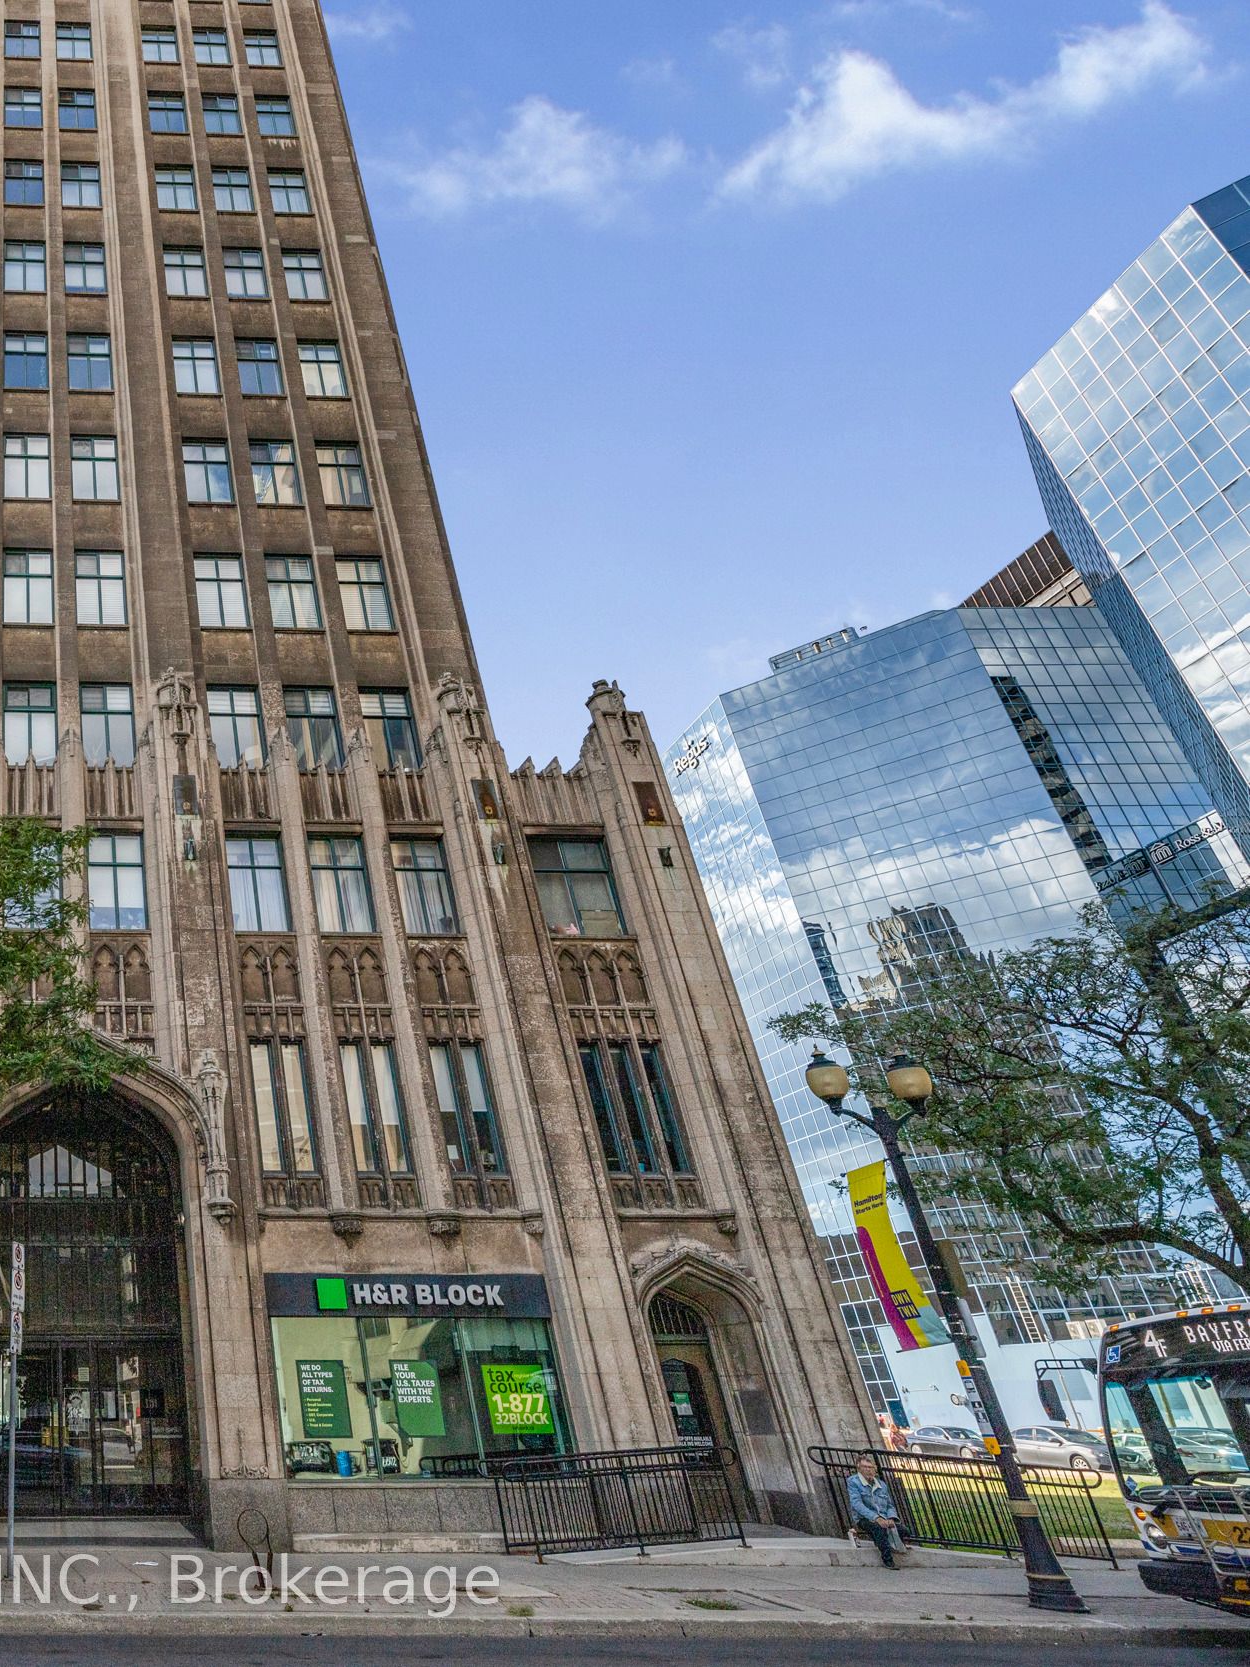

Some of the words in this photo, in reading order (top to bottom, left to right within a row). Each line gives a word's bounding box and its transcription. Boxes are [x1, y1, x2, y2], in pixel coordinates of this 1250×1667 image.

[673, 739, 710, 775] Regus
[1174, 833, 1201, 851] Ross
[853, 1193, 883, 1207] Hamilton
[352, 1283, 409, 1305] H&R
[414, 1284, 505, 1306] BLOCK
[1182, 1319, 1250, 1344] BAYFR
[1211, 1340, 1234, 1353] VIA
[393, 1363, 410, 1371] FILE
[394, 1371, 416, 1379] YOUR
[487, 1368, 515, 1382] tax
[396, 1379, 410, 1387] U.S.
[411, 1379, 435, 1387] TAXES
[490, 1382, 543, 1393] course
[396, 1387, 417, 1395] WITH
[417, 1387, 433, 1395] THE
[397, 1395, 434, 1403] EXPERTS.
[492, 1393, 545, 1413] 1-877
[494, 1413, 550, 1425] 32BLOCK
